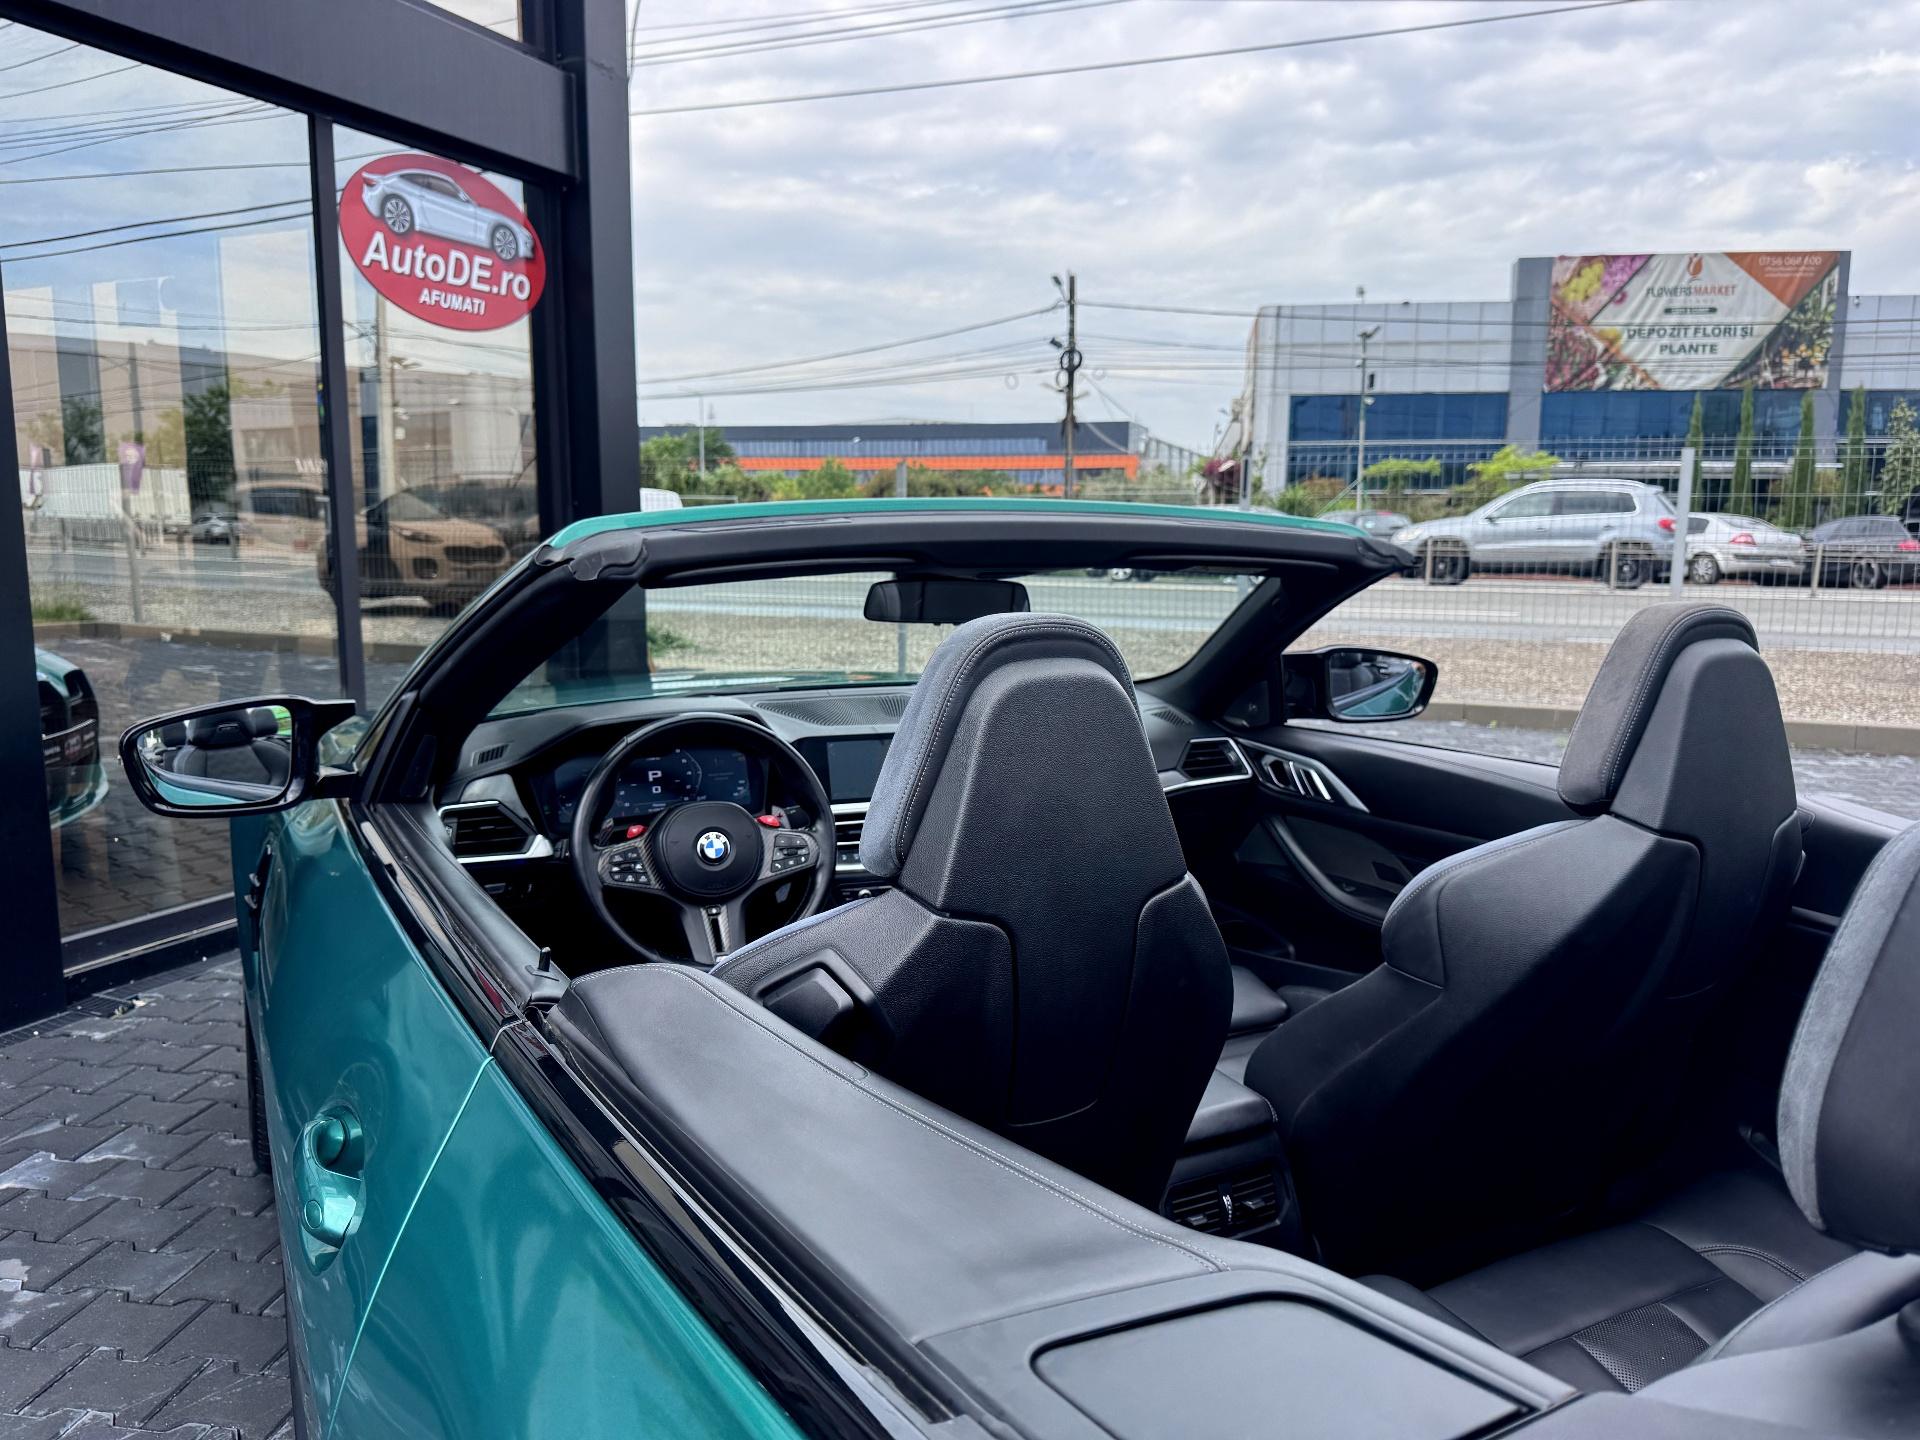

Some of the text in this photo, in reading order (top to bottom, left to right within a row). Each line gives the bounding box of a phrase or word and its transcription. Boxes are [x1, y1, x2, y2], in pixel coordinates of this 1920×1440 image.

[362, 231, 531, 301] AutoDE.ro
[419, 287, 486, 316] AFUMATI
[1627, 327, 1691, 339] DEPOZIT
[1694, 326, 1737, 338] FLORI
[1660, 344, 1719, 355] PLANTE
[648, 770, 662, 782] P
